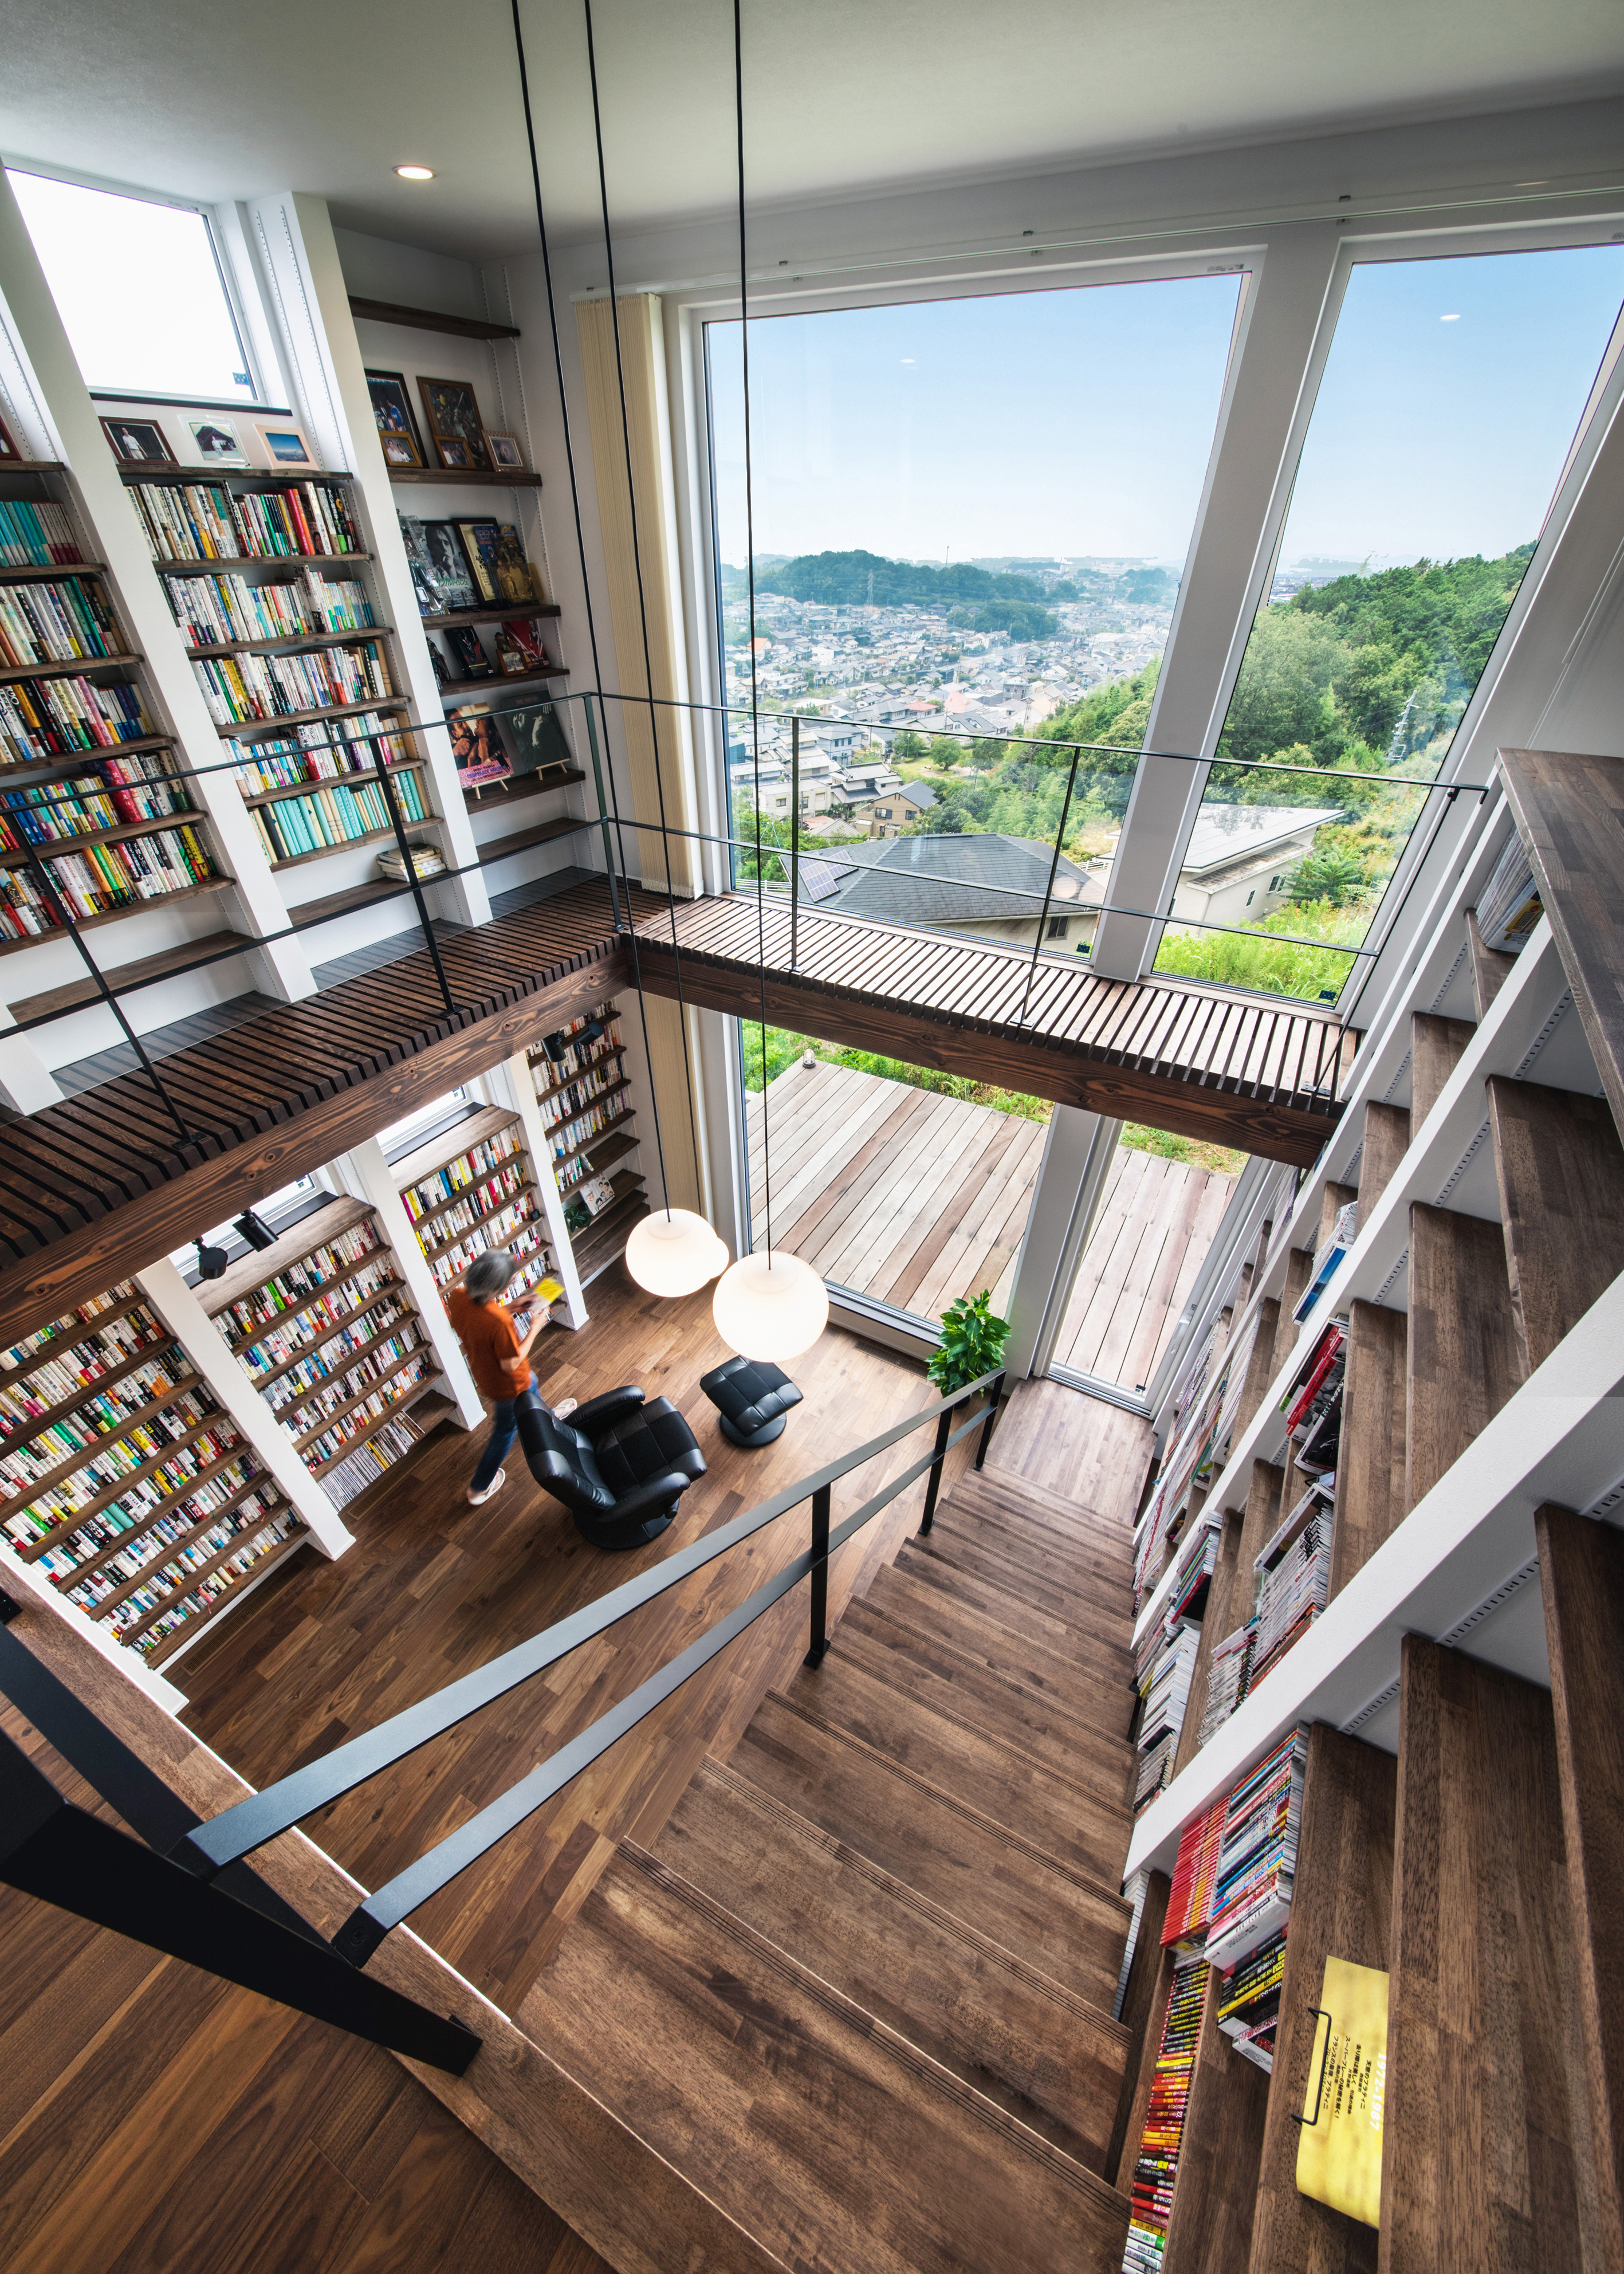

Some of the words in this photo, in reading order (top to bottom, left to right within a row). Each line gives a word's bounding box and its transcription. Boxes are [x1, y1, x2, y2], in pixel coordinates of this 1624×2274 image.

[6, 688, 19, 706] GO
[466, 768, 489, 779] DESPERATE
[4, 882, 23, 908] 天皇論
[1351, 2044, 1361, 2084] 去り際は美しく
[1369, 2052, 1387, 2131] 1972-1987
